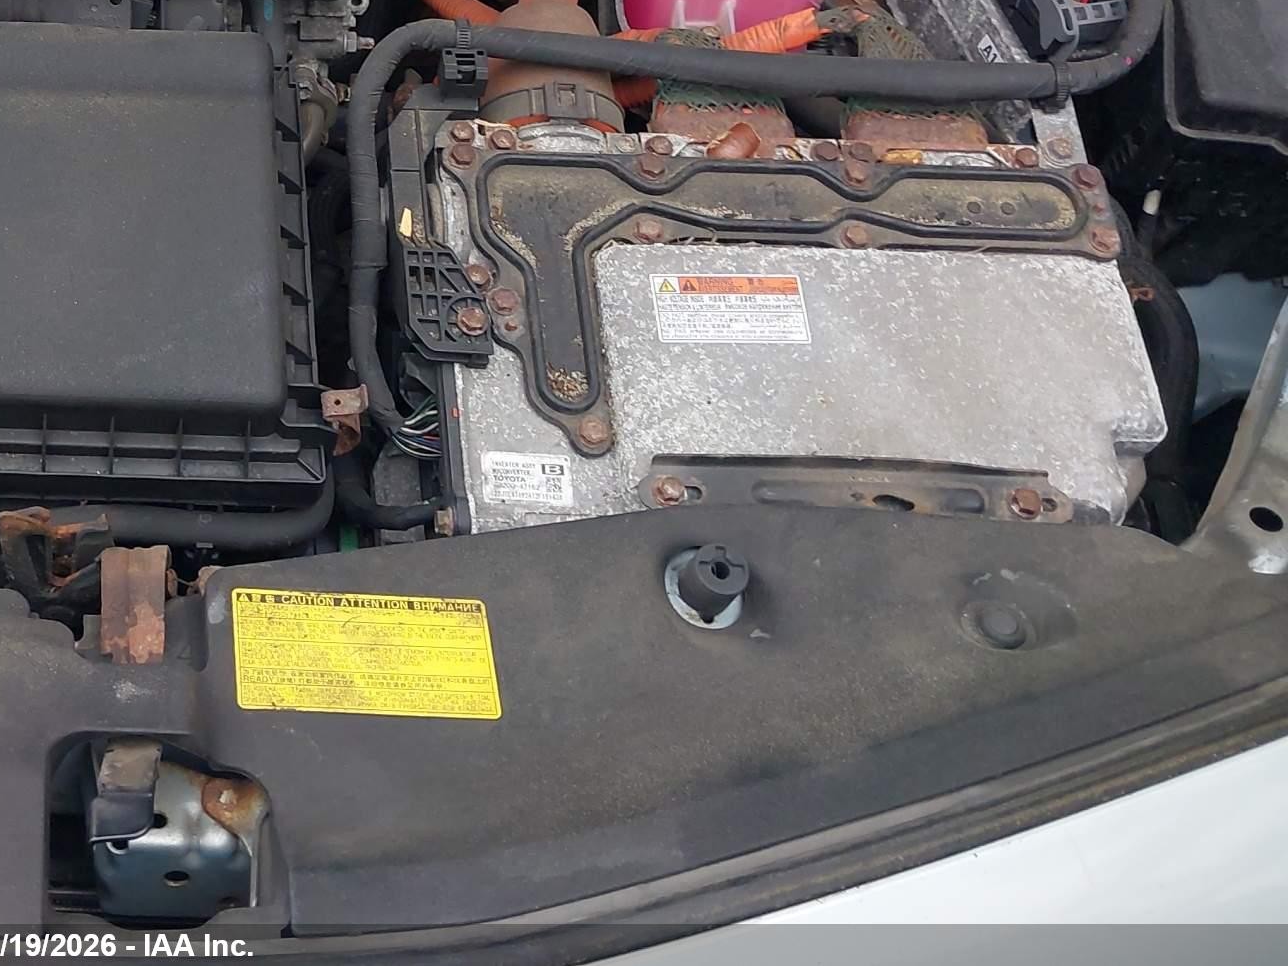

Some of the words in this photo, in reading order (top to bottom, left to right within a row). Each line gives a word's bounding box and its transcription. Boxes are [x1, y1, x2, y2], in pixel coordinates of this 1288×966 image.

[281, 596, 335, 607] CAUTION
[340, 598, 408, 610] ATTENTION
[413, 601, 481, 613] ВНИМАНИЕ
